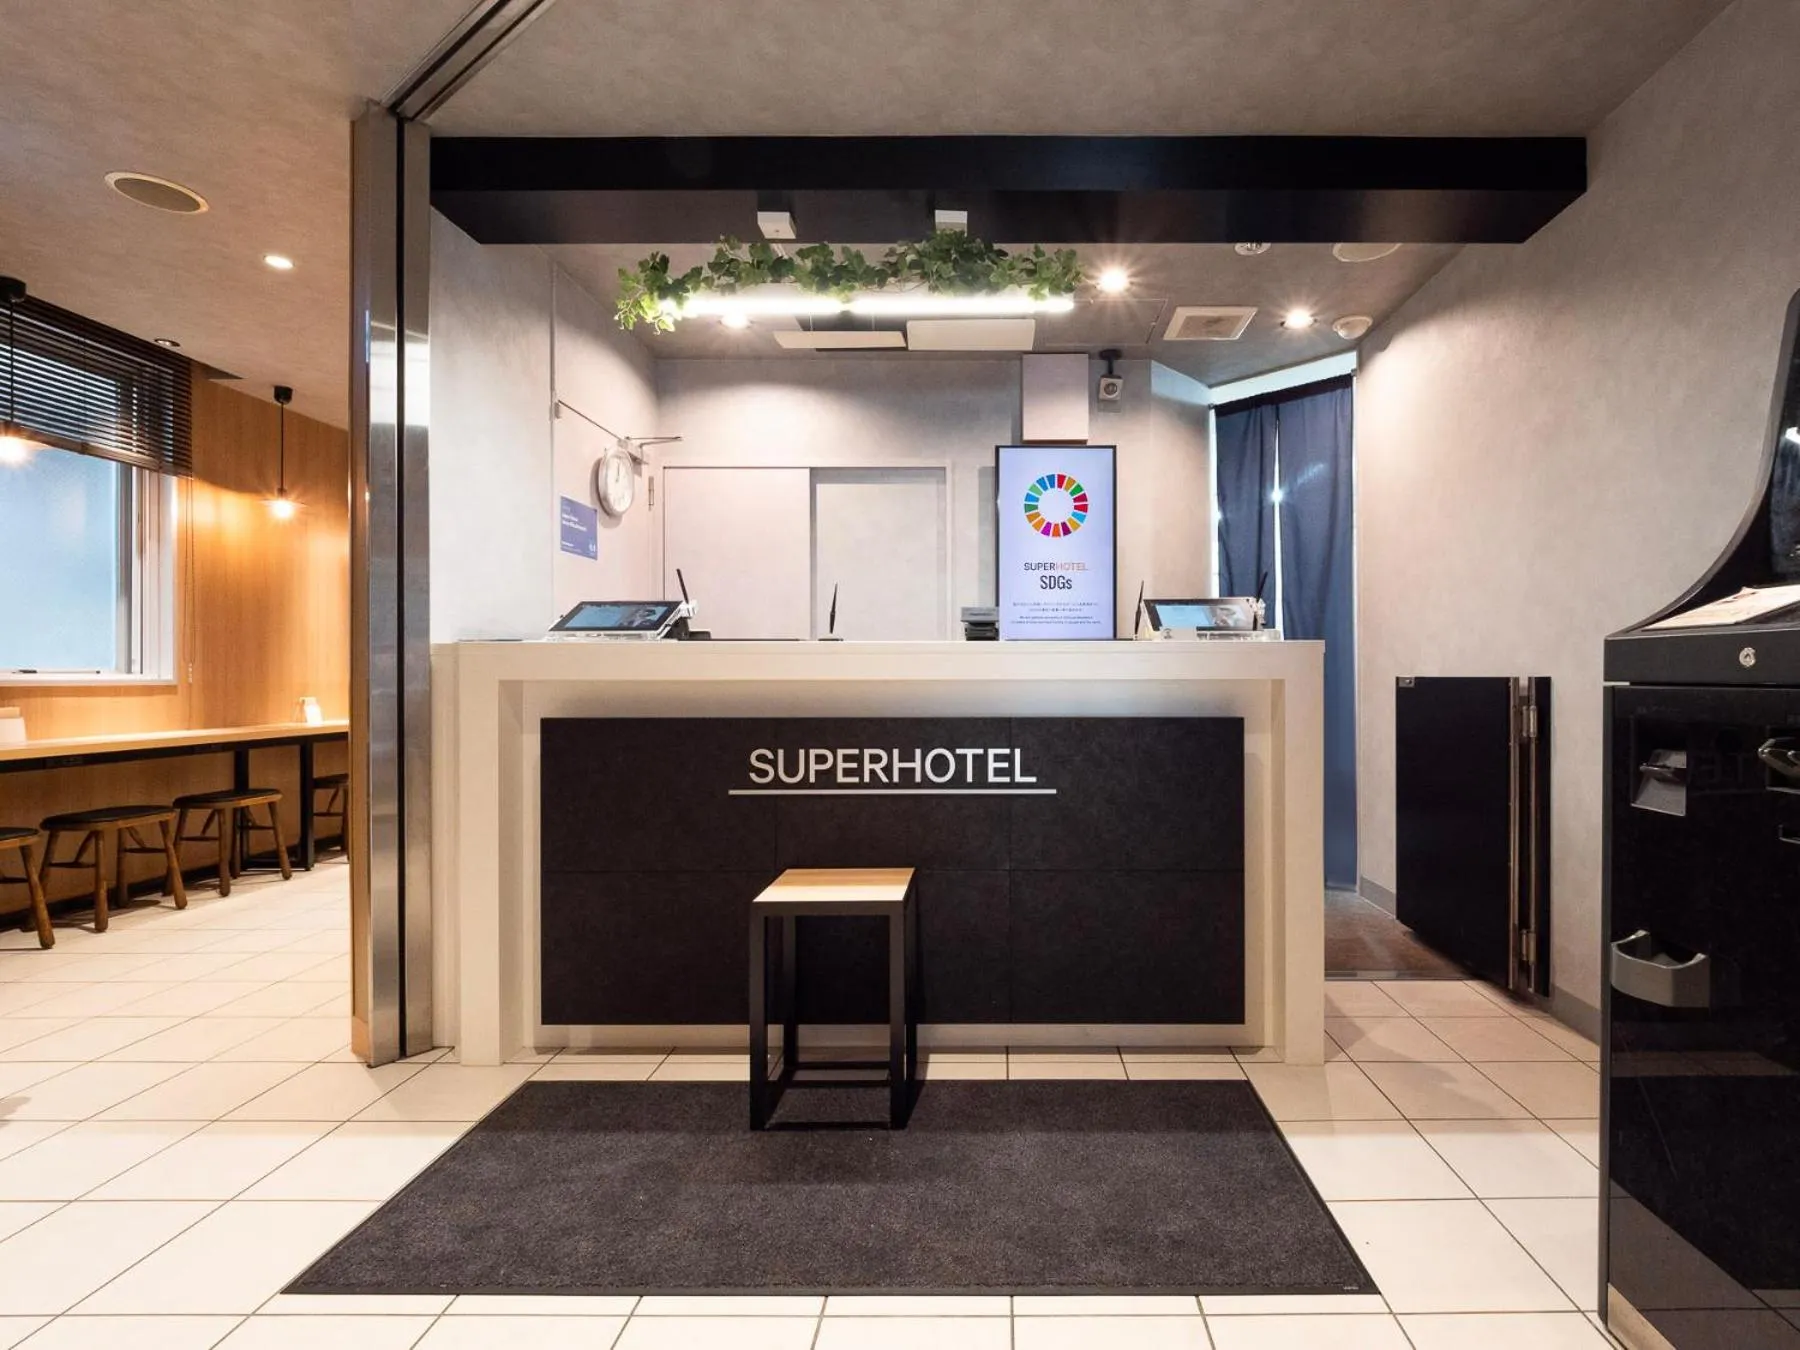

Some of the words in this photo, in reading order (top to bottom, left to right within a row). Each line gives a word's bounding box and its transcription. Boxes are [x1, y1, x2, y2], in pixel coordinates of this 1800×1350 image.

[1023, 562, 1088, 571] SUPERHOTEL
[1040, 575, 1072, 590] SDGs
[749, 747, 1037, 783] SUPERHOTEL
